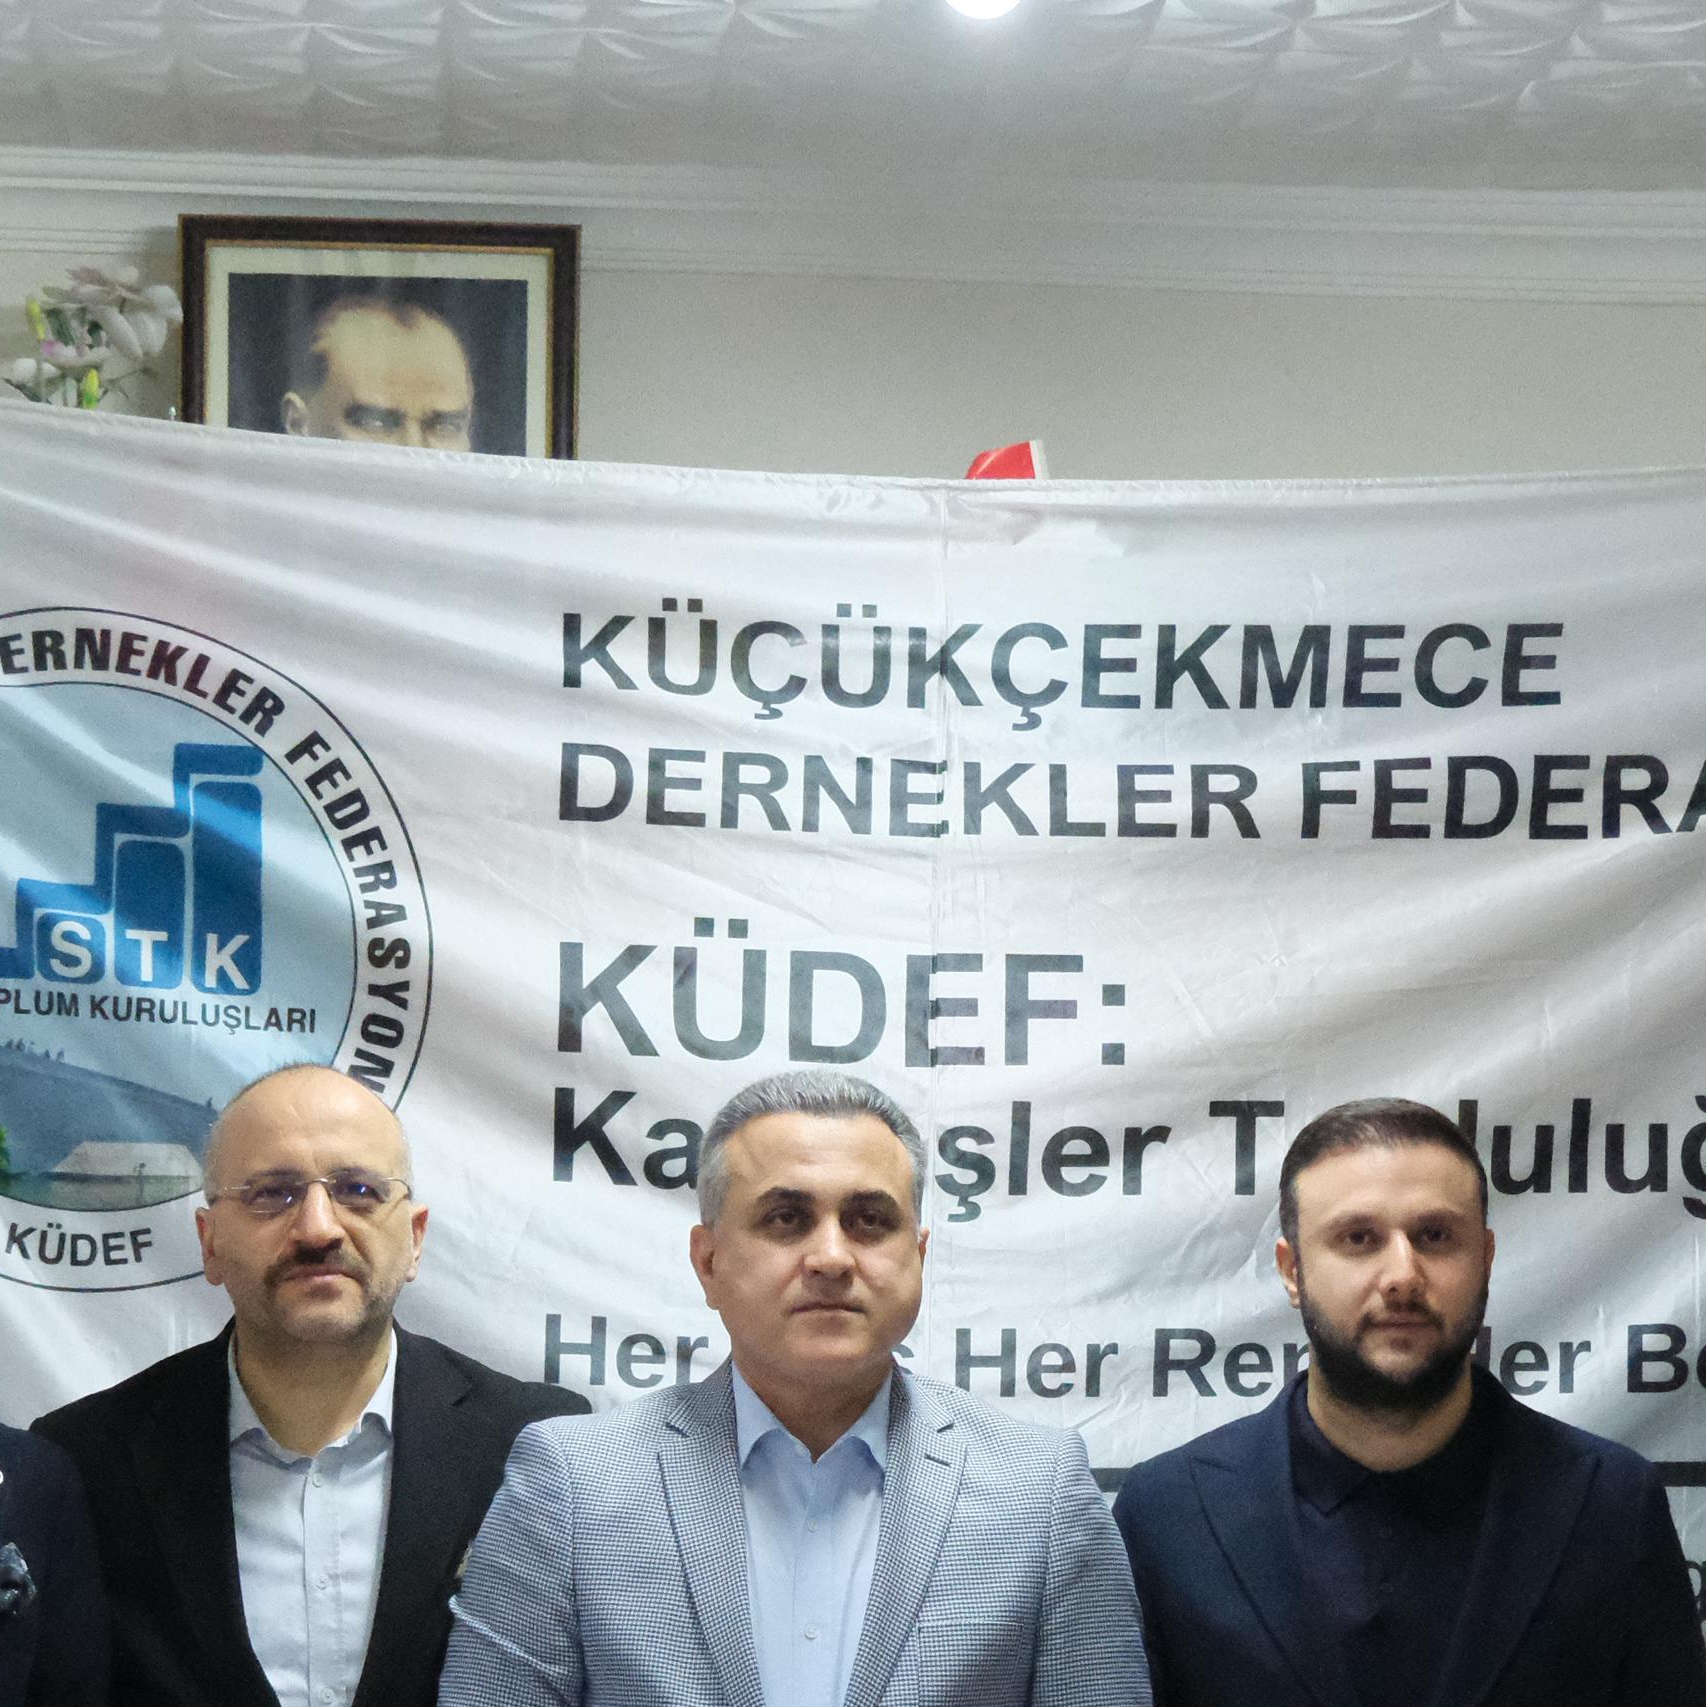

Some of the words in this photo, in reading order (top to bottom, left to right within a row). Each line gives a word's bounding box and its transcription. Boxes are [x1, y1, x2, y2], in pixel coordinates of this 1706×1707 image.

[561, 598, 1565, 732] KÜÇÜKÇEKMECE
[558, 742, 1261, 839] DERNEKLER
[49, 920, 250, 990] STK
[286, 731, 413, 1093] FEDERASYON
[89, 994, 317, 1036] KURULUŞLARI
[557, 917, 1127, 1068] KÜDEF:
[552, 1087, 1173, 1222] Kaşler
[4, 1223, 155, 1268] KÜDEF
[543, 1313, 710, 1389] Her
[954, 1327, 1120, 1398] Her
